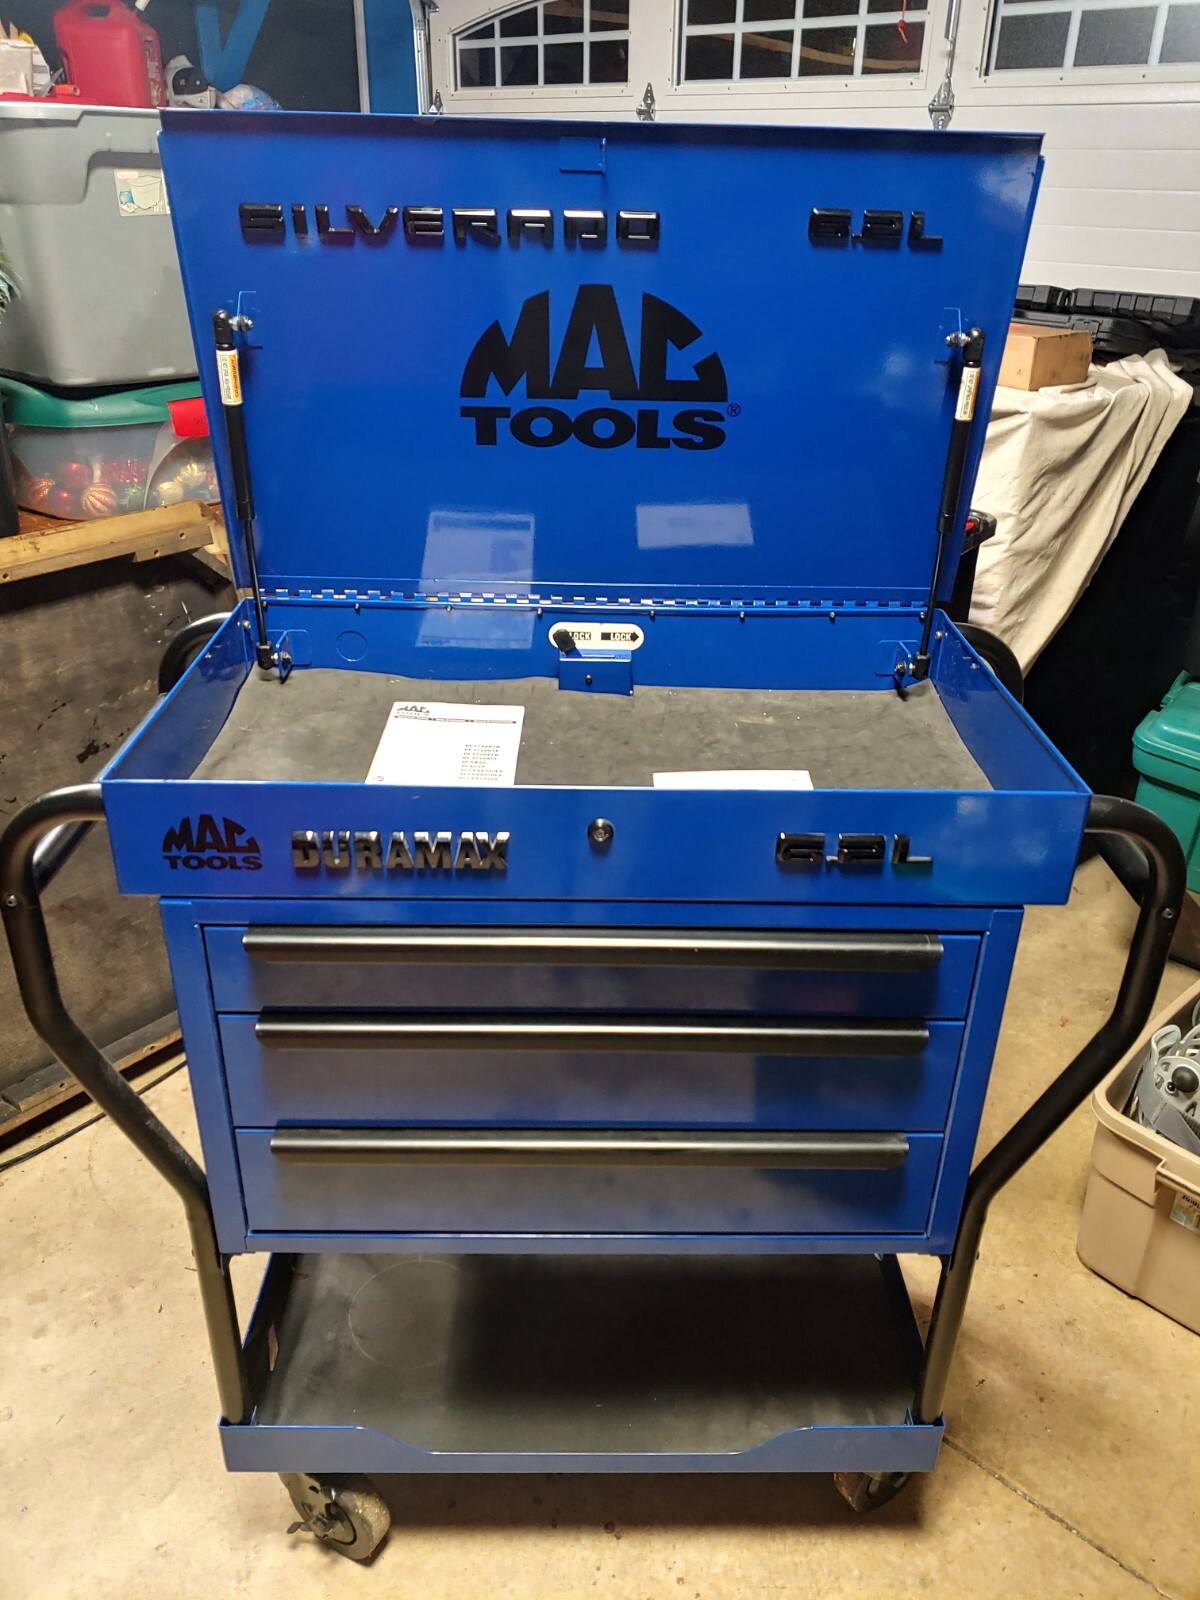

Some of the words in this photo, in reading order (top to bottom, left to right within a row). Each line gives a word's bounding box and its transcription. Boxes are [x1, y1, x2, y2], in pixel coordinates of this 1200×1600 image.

[238, 203, 661, 245] SILVERADO
[808, 208, 943, 248] 6.2L
[459, 284, 728, 402] MAC
[610, 632, 632, 641] LOCK
[162, 814, 260, 853] MAC
[291, 830, 511, 870] DURAMAX
[776, 832, 933, 864] 6.2L
[163, 856, 263, 870] TOOLS
